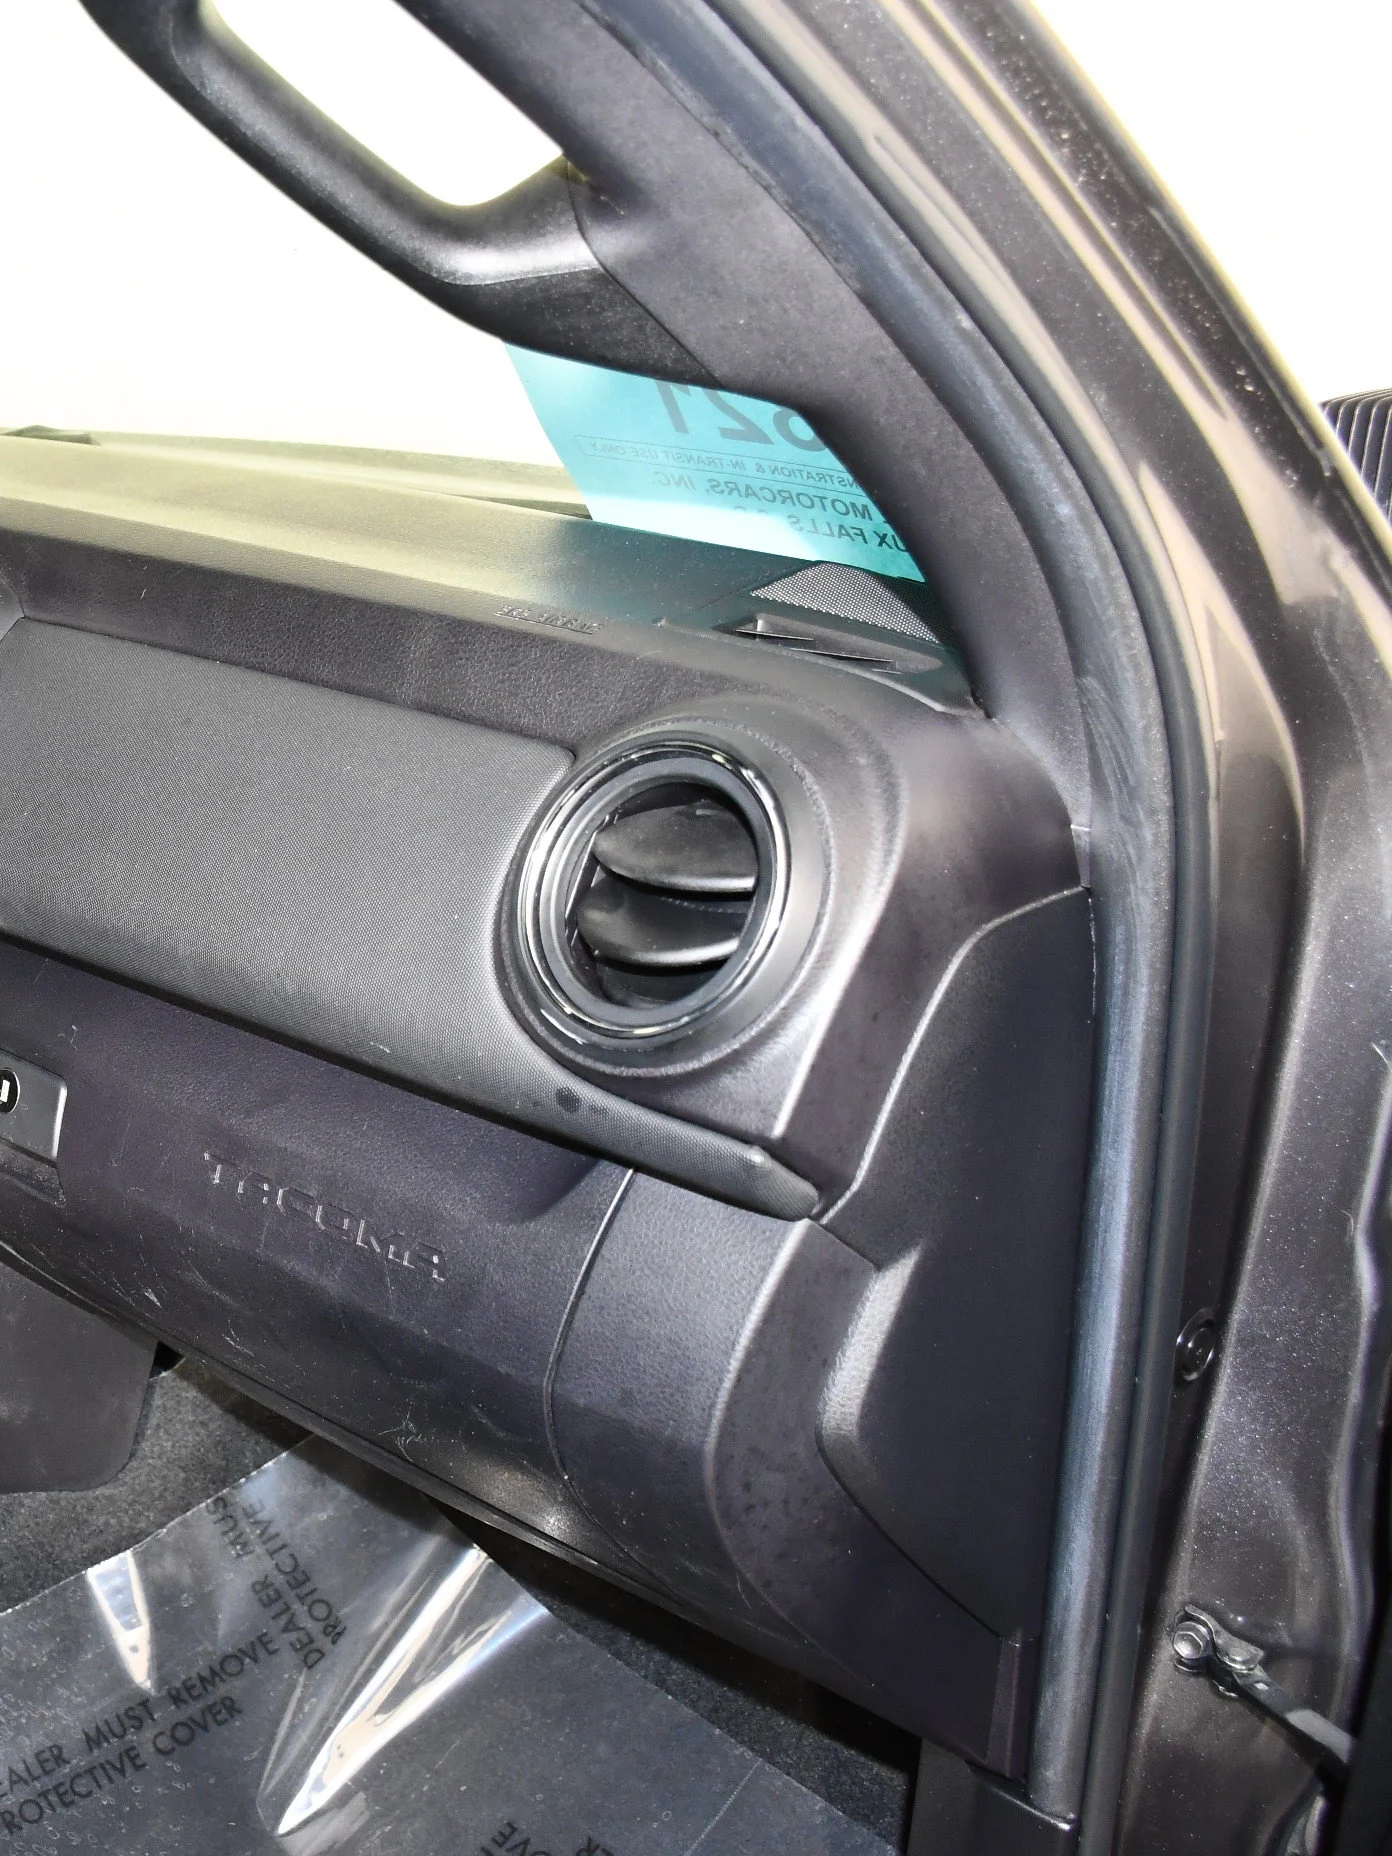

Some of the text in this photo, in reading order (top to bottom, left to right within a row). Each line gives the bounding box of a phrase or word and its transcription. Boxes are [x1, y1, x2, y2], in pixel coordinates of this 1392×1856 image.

[203, 1152, 446, 1282] TACOMA
[241, 1498, 347, 1646] PROTECTIVE
[251, 1573, 325, 1670] DEALER
[81, 1698, 158, 1755] MUST
[166, 1631, 281, 1710] REMOVE
[151, 1694, 244, 1757] COVER
